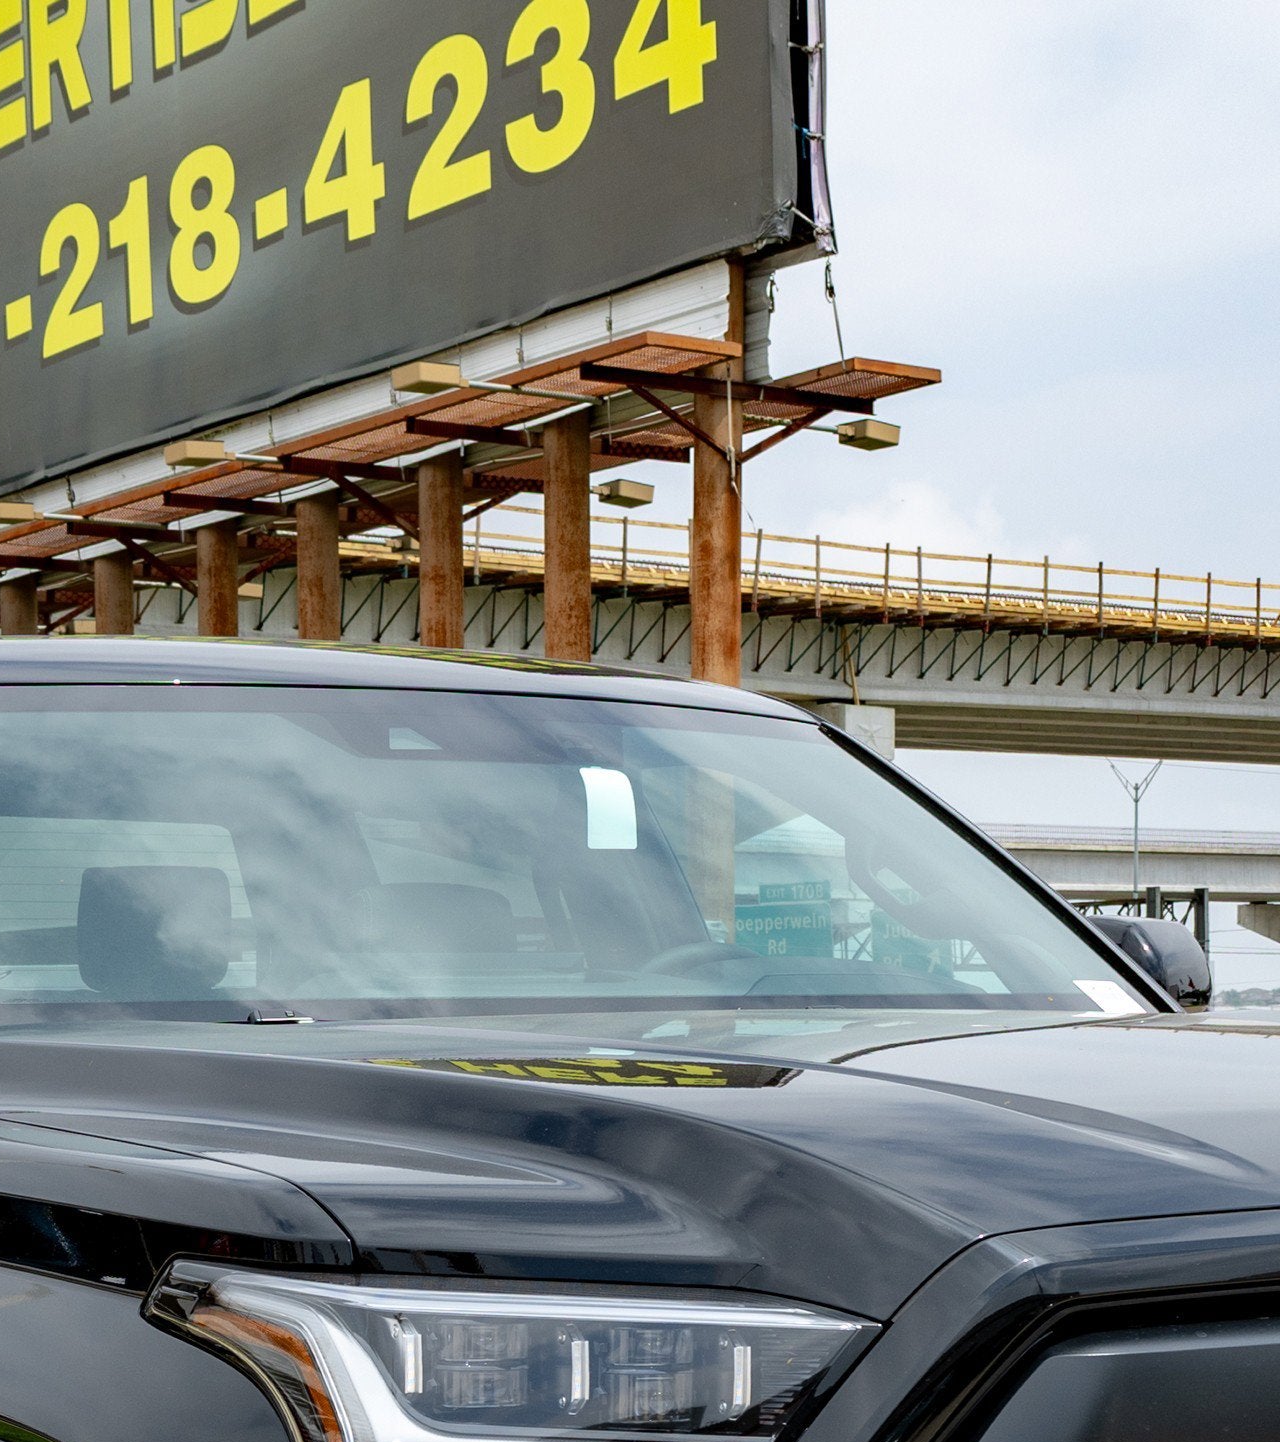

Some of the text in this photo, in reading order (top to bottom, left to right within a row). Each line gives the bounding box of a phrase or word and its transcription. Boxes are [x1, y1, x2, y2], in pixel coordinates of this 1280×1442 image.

[766, 887, 785, 899] EXIT
[735, 911, 827, 935] oepperwein
[767, 937, 787, 956] Rd
